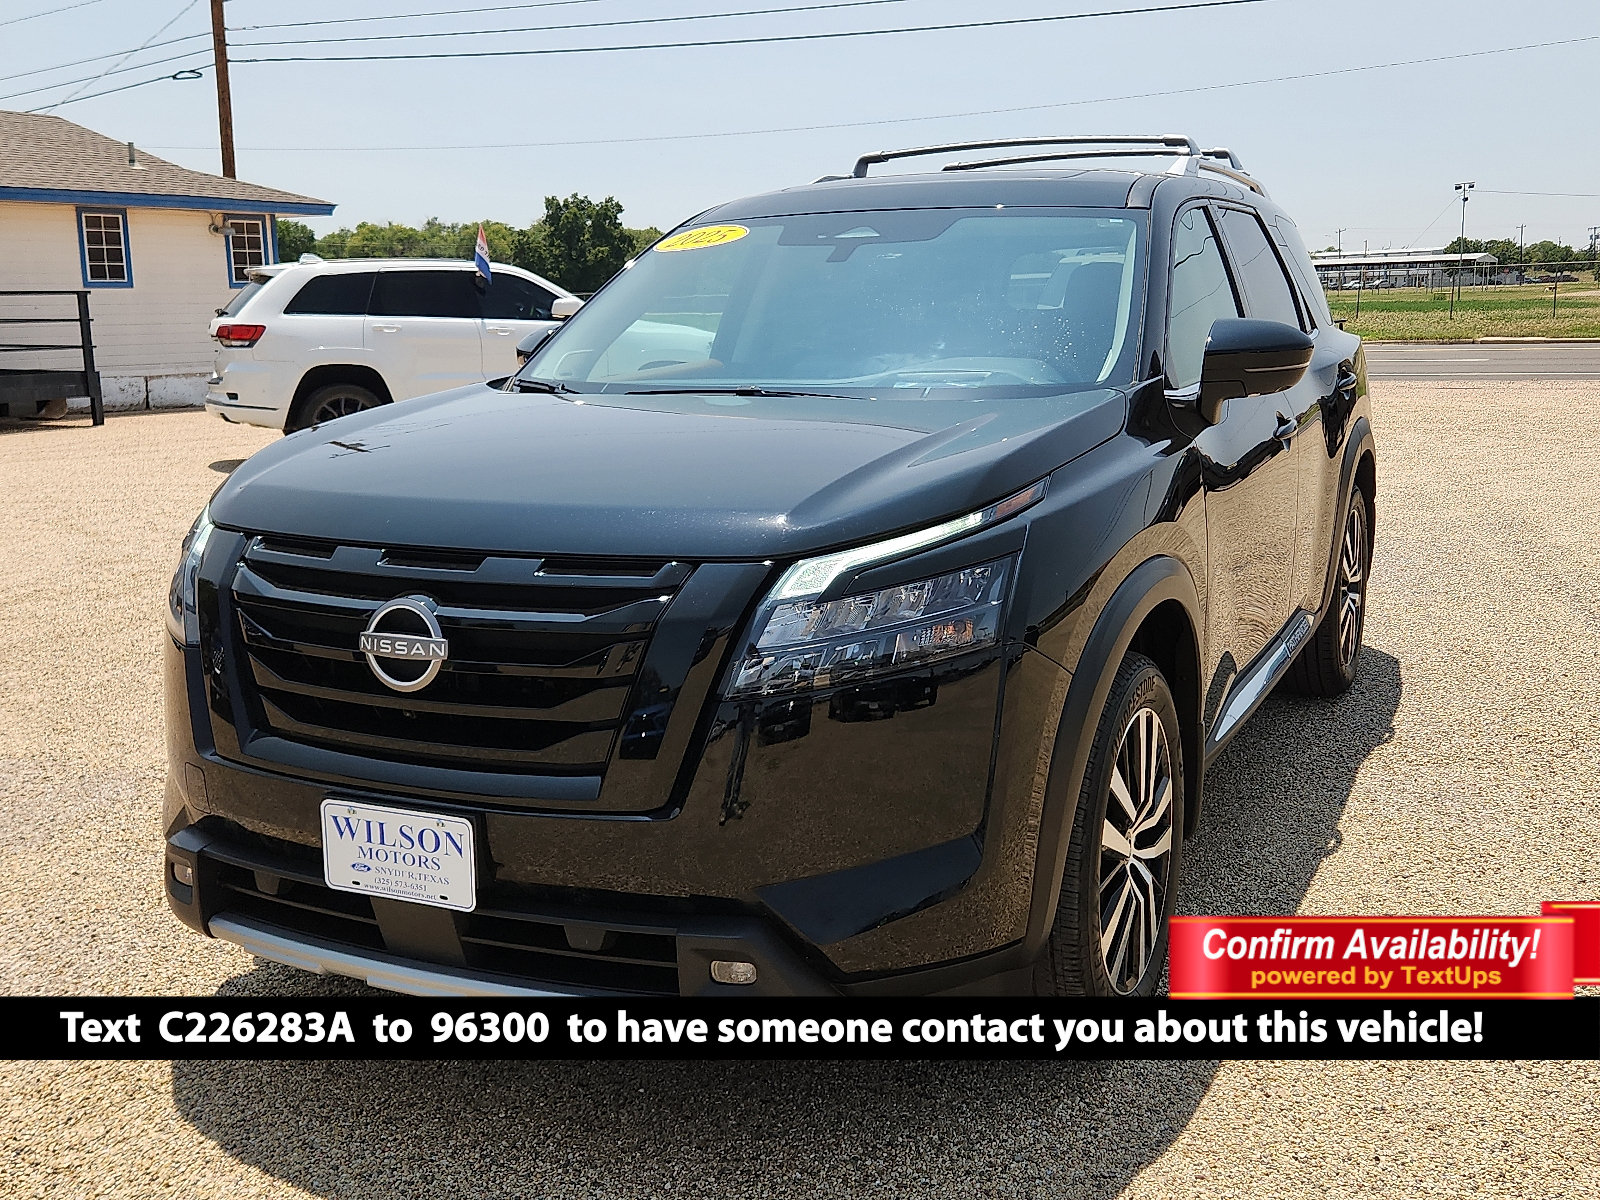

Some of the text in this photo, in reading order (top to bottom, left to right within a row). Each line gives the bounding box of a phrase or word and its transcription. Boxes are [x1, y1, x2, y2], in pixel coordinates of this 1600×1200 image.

[663, 229, 737, 249] 2025
[361, 635, 445, 657] NISSAN
[329, 814, 465, 859] WILSON
[357, 845, 442, 872] MOTORS
[364, 883, 437, 900] www.wilsonmotors.net
[374, 877, 427, 892] (325) 573-6351
